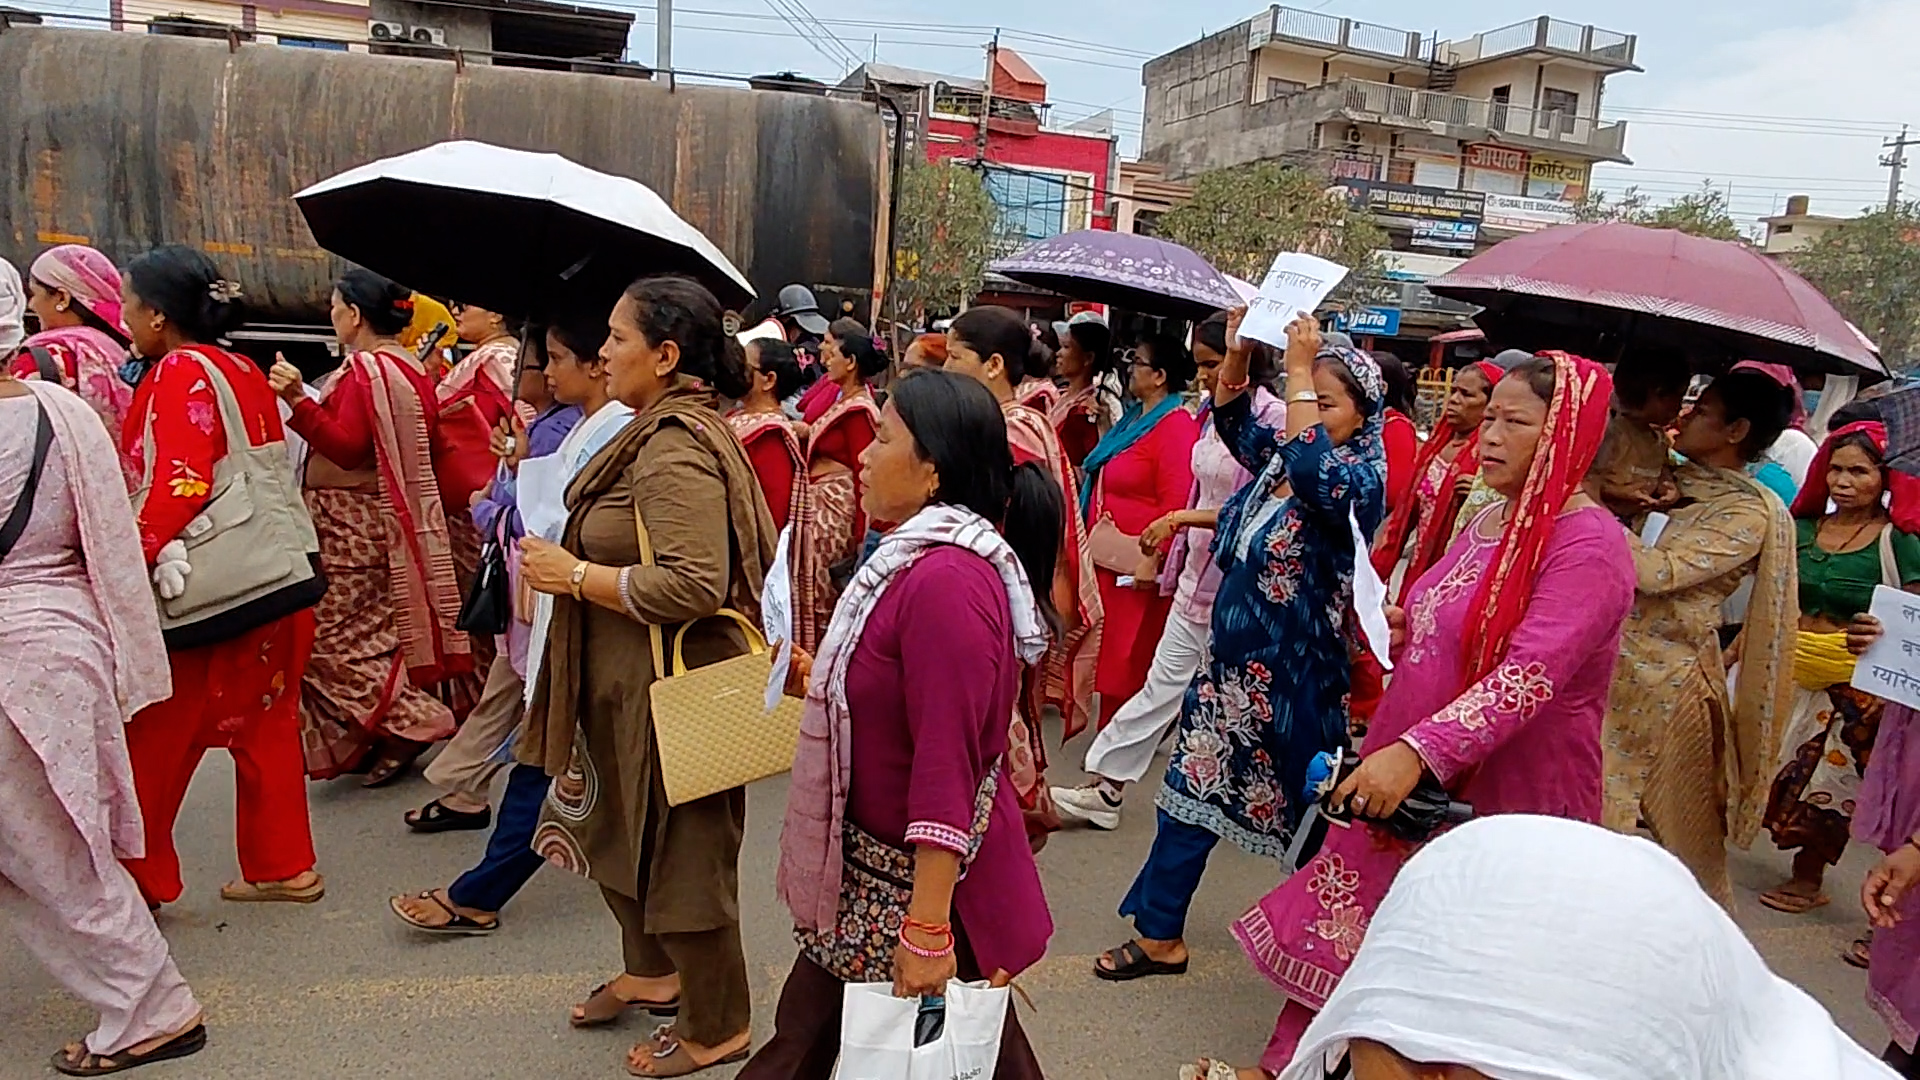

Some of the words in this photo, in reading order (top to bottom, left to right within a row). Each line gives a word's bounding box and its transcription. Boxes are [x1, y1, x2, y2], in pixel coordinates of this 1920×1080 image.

[1471, 145, 1523, 170] जापान
[1532, 159, 1582, 181] कोरिया
[1436, 197, 1484, 212] CONSULTANCY
[1275, 270, 1323, 291] सुशासन
